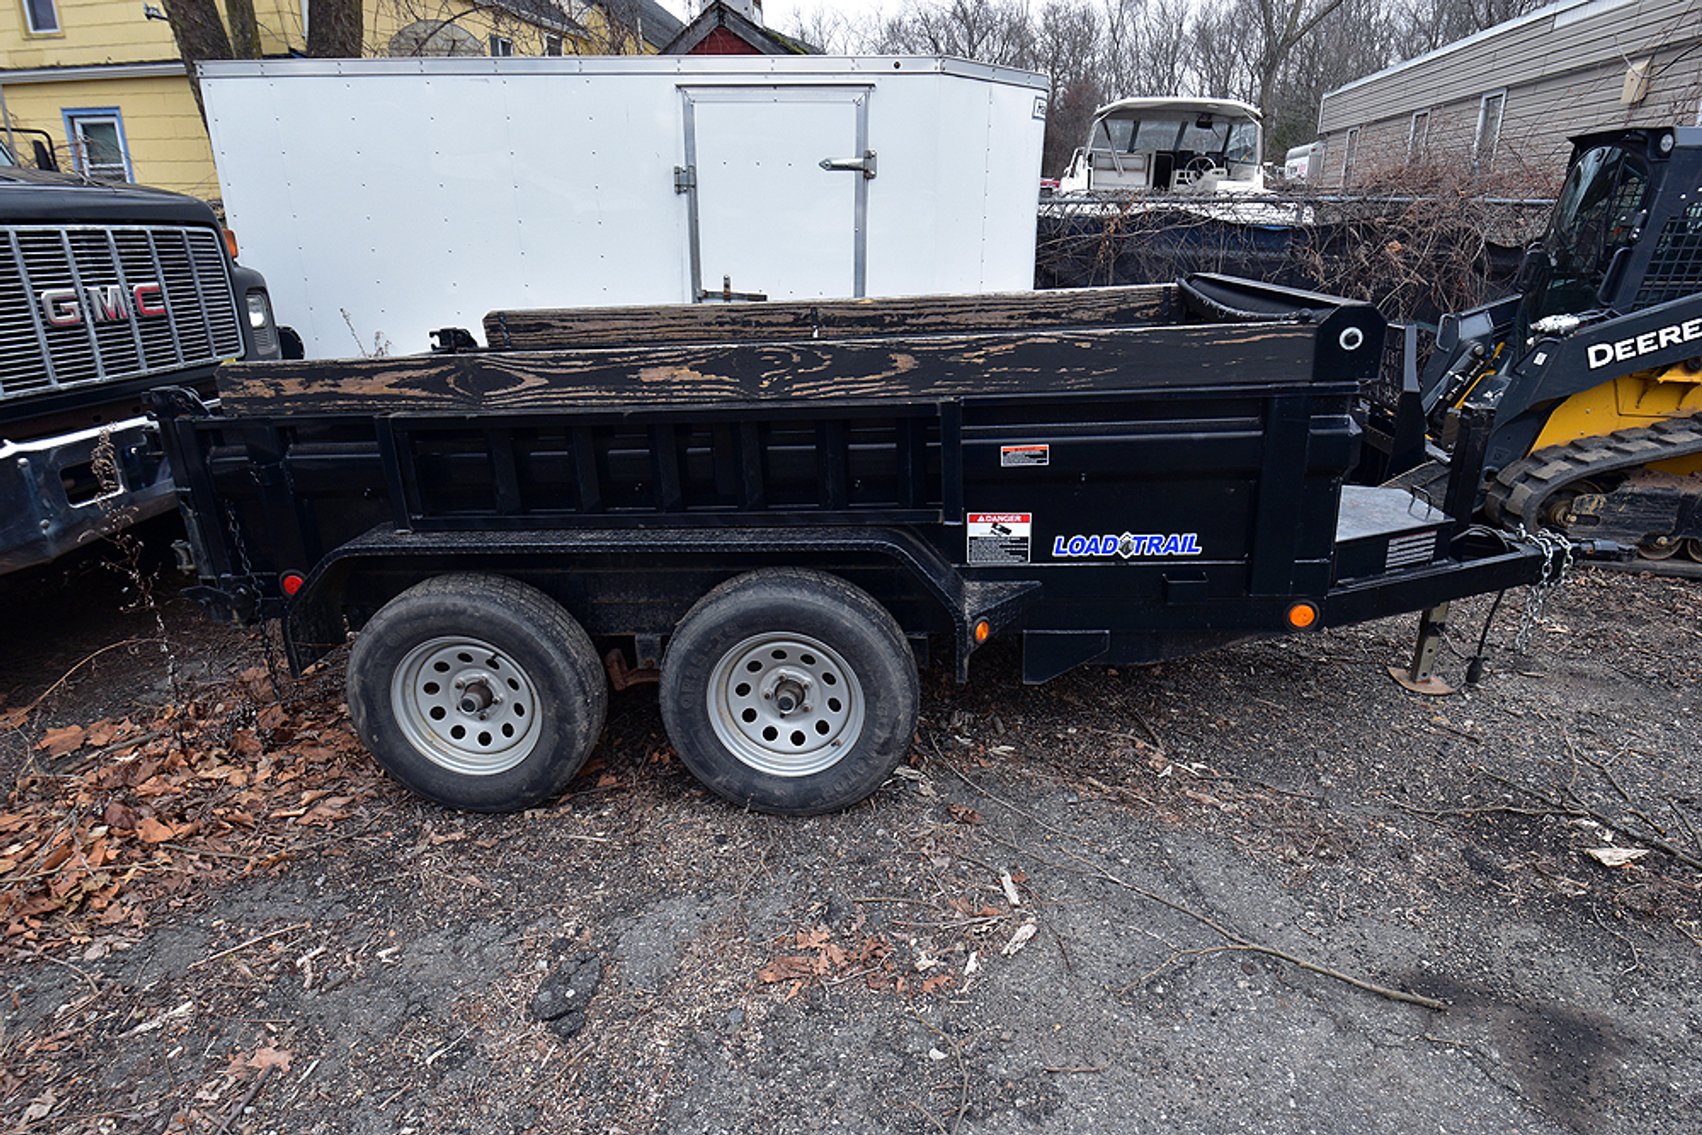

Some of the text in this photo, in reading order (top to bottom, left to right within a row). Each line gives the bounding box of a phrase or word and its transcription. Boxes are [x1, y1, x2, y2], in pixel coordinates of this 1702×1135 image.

[41, 282, 166, 326] GMC
[1587, 318, 1702, 369] DEERE
[1052, 535, 1119, 557] LOAD
[1131, 533, 1202, 556] TRAIL
